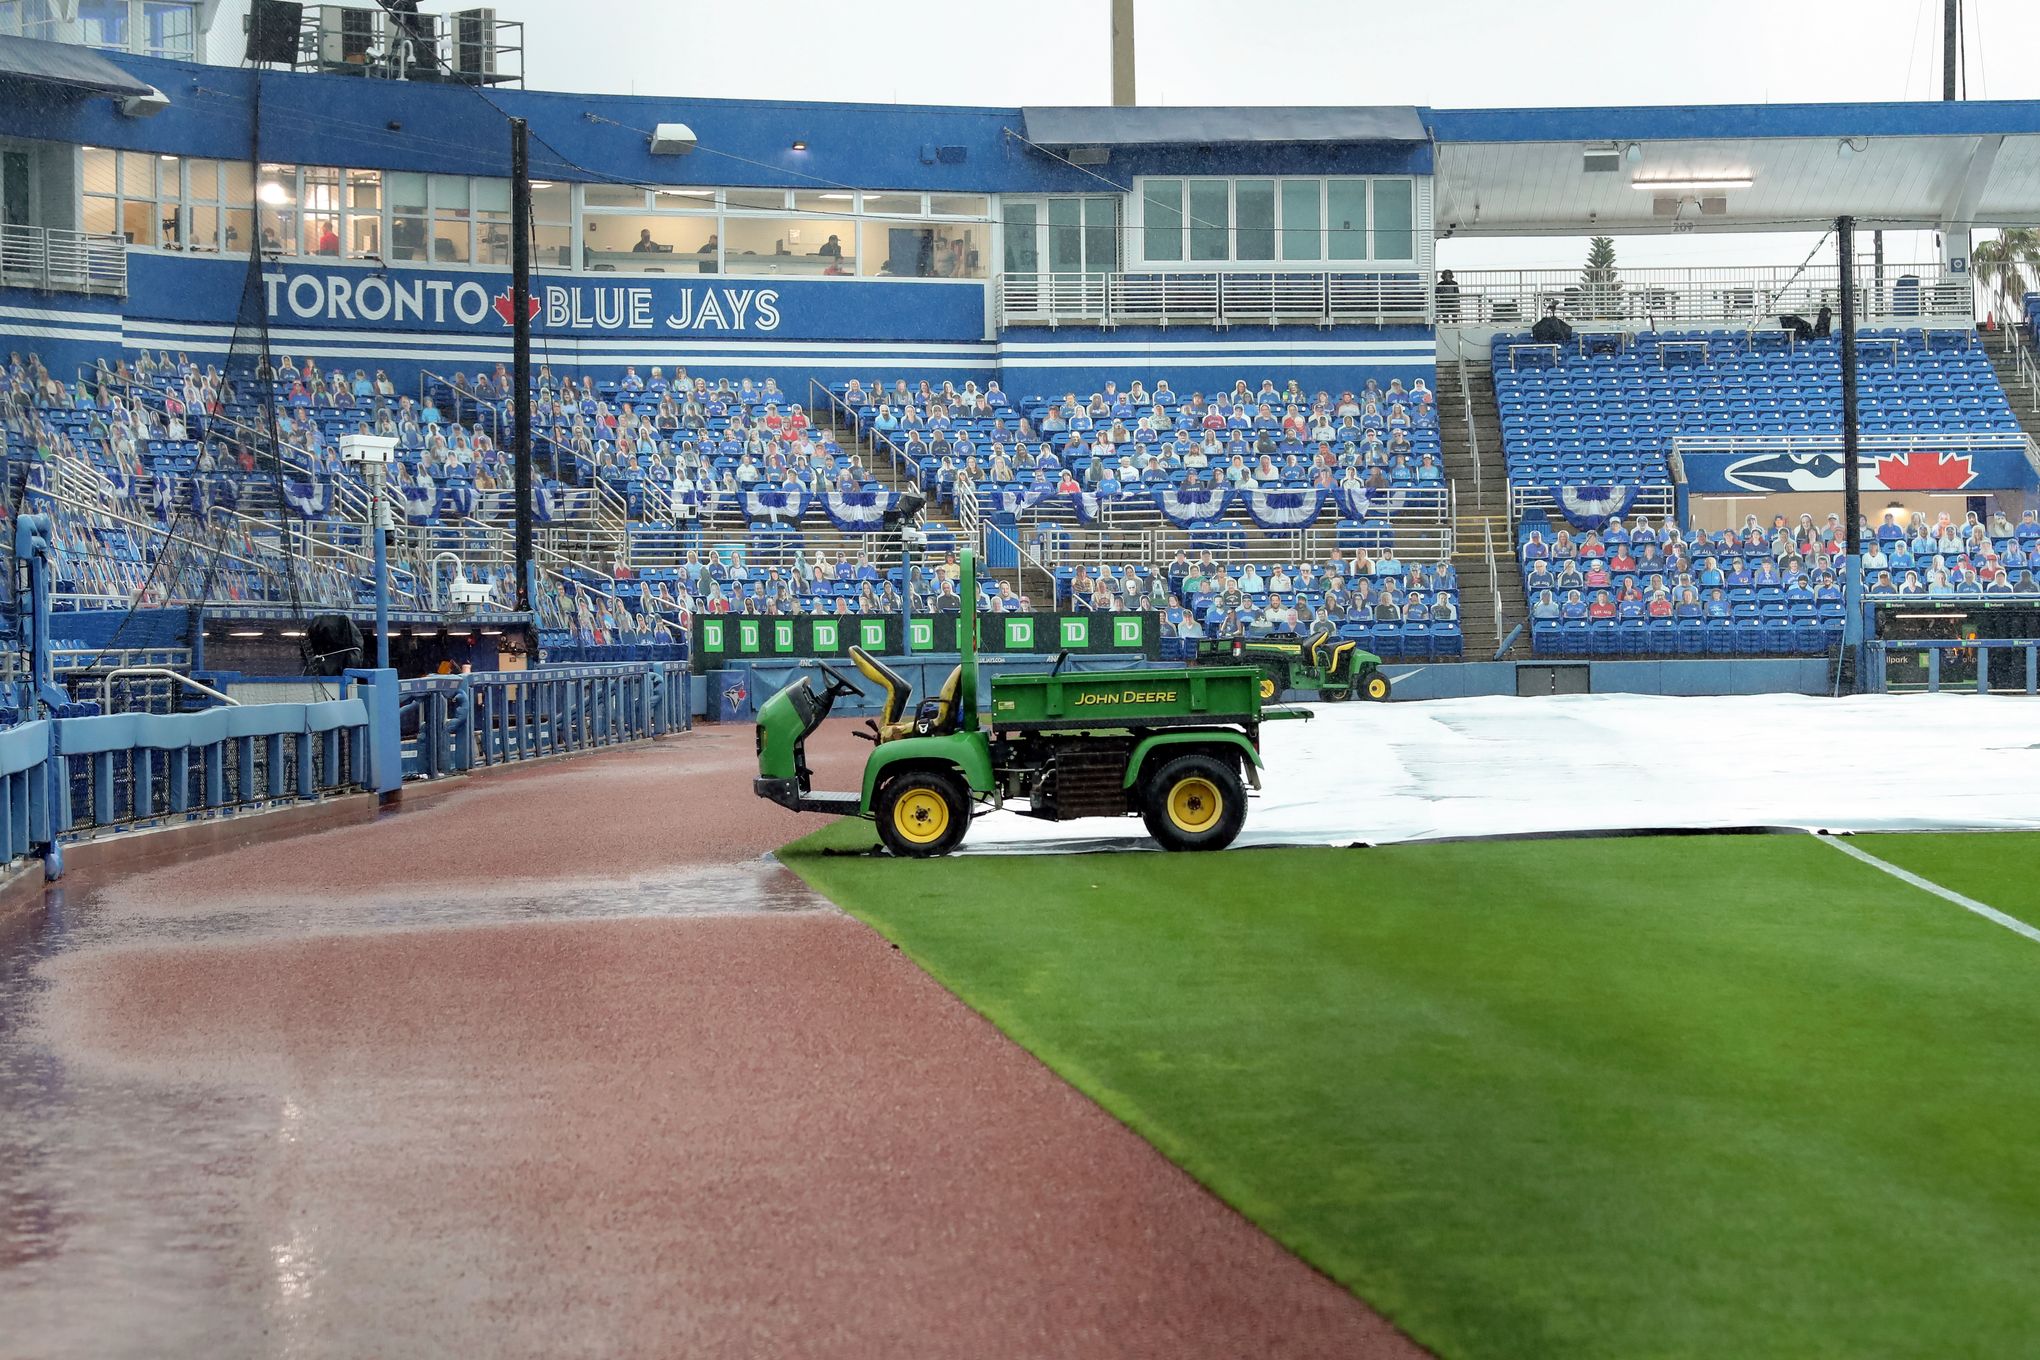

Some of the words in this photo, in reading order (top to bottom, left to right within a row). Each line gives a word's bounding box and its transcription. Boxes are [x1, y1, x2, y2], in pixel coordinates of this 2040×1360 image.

[1673, 222, 1694, 232] 209
[262, 273, 489, 325] TORONTO
[546, 285, 654, 329] BLUE
[666, 287, 781, 331] JAYS
[705, 625, 721, 646] TD
[740, 625, 757, 646] TD
[776, 625, 791, 646] TD
[815, 625, 836, 646] TD
[862, 625, 883, 645] TD
[1008, 623, 1031, 642] TD
[1063, 622, 1086, 642] TD
[1116, 622, 1140, 641] TD
[1886, 655, 1909, 664] llpark
[1075, 692, 1120, 705] JOHN
[1122, 690, 1177, 703] DEERE
